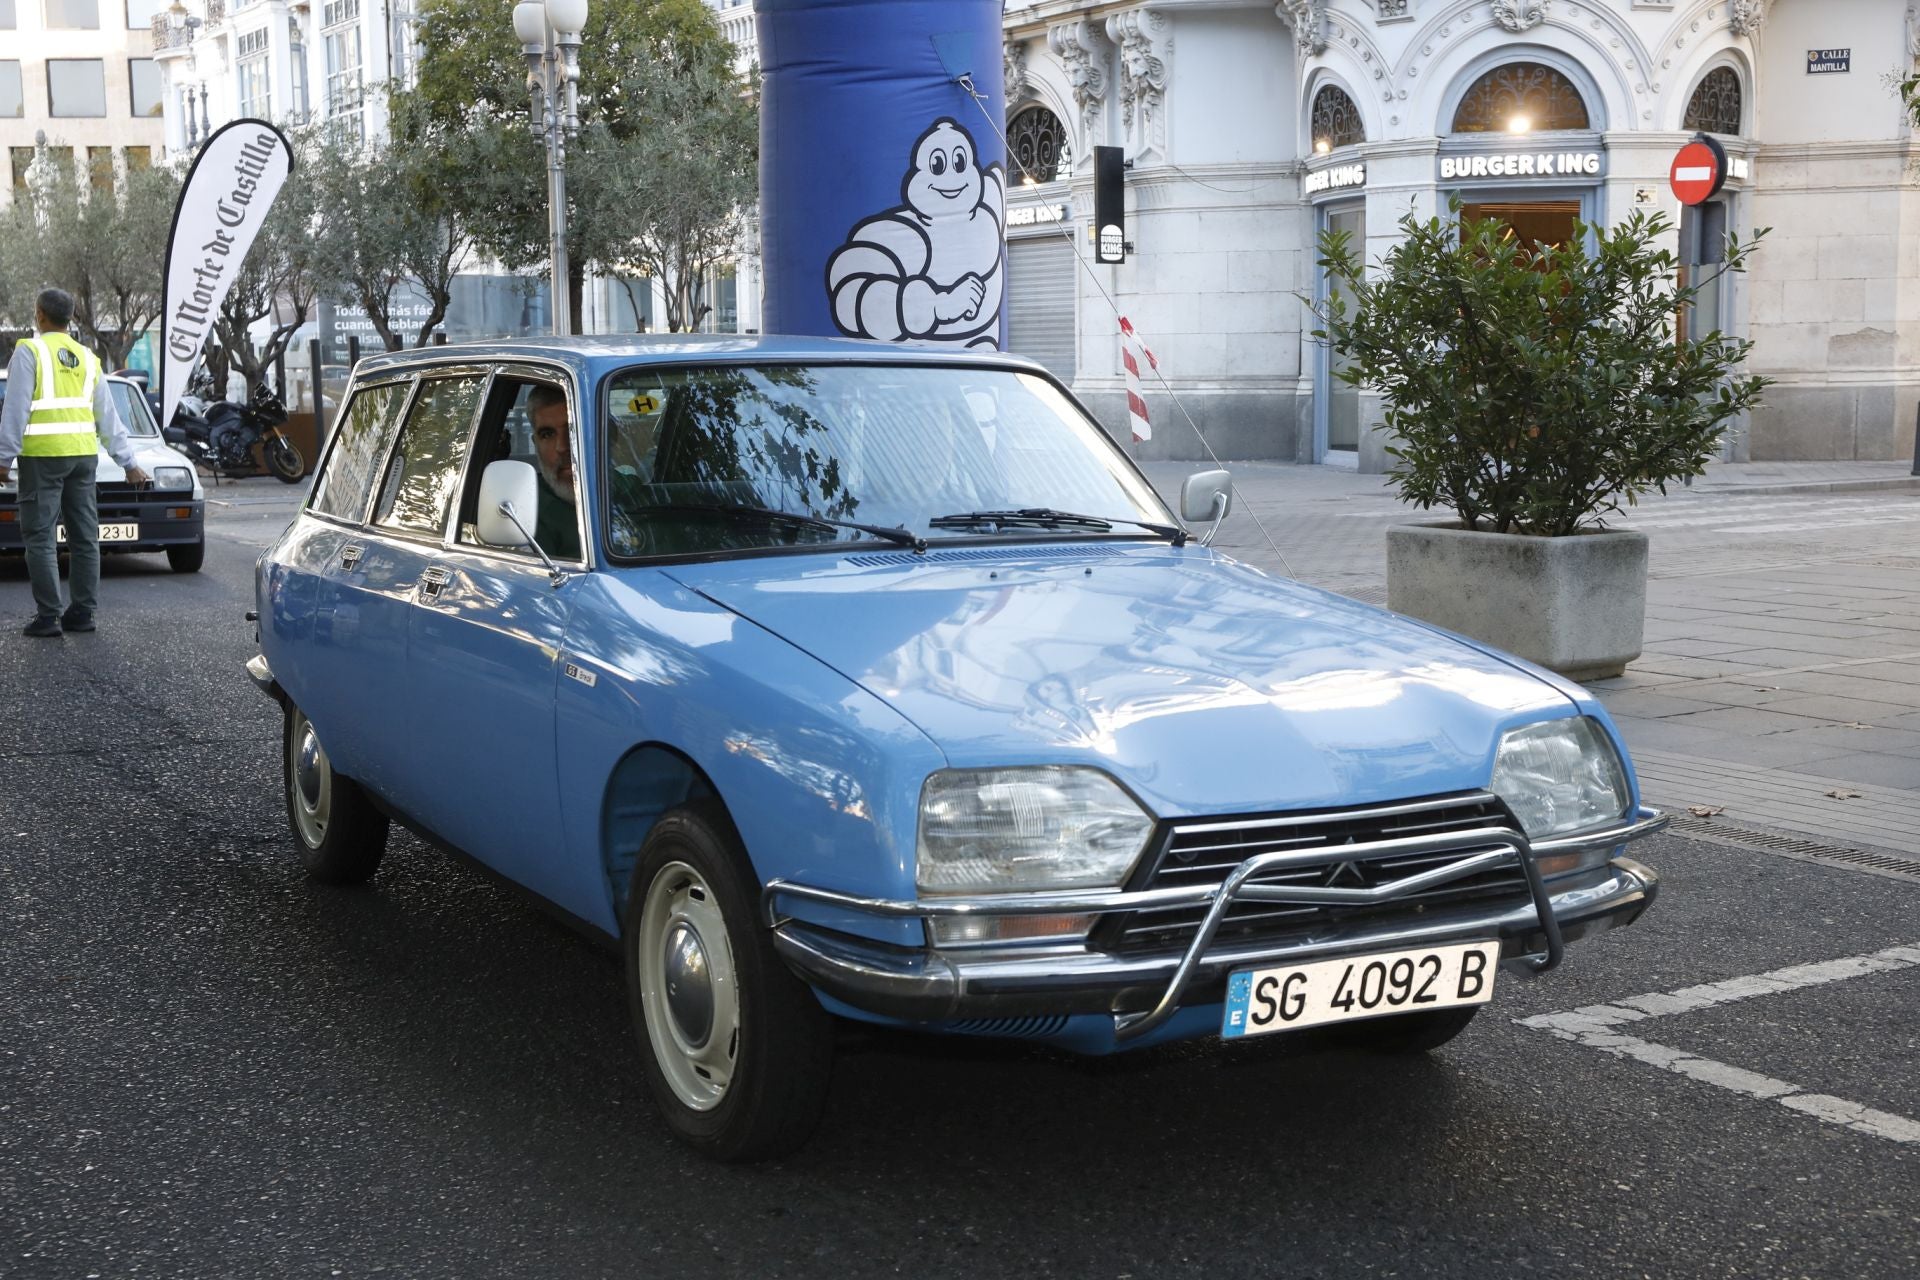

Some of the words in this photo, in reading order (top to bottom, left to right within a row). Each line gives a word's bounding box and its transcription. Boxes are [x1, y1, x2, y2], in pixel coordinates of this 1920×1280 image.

[1822, 50, 1849, 60] CALLE
[1810, 62, 1847, 72] MANTILLA
[1440, 153, 1535, 178] BURGER
[1537, 153, 1600, 175] KING
[216, 132, 278, 227] Castilla
[1330, 164, 1364, 187] KING
[1036, 203, 1064, 222] KING
[202, 228, 235, 256] de
[1101, 235, 1123, 244] BURGER
[1101, 243, 1123, 254] KING
[176, 258, 224, 325] Norte
[334, 319, 376, 330] cuand
[169, 327, 202, 362] El
[335, 332, 347, 344] el
[634, 397, 653, 412] H
[1251, 972, 1308, 1025] SG
[1330, 954, 1442, 1013] 4092
[1457, 950, 1487, 999] B
[1230, 1010, 1242, 1025] E
